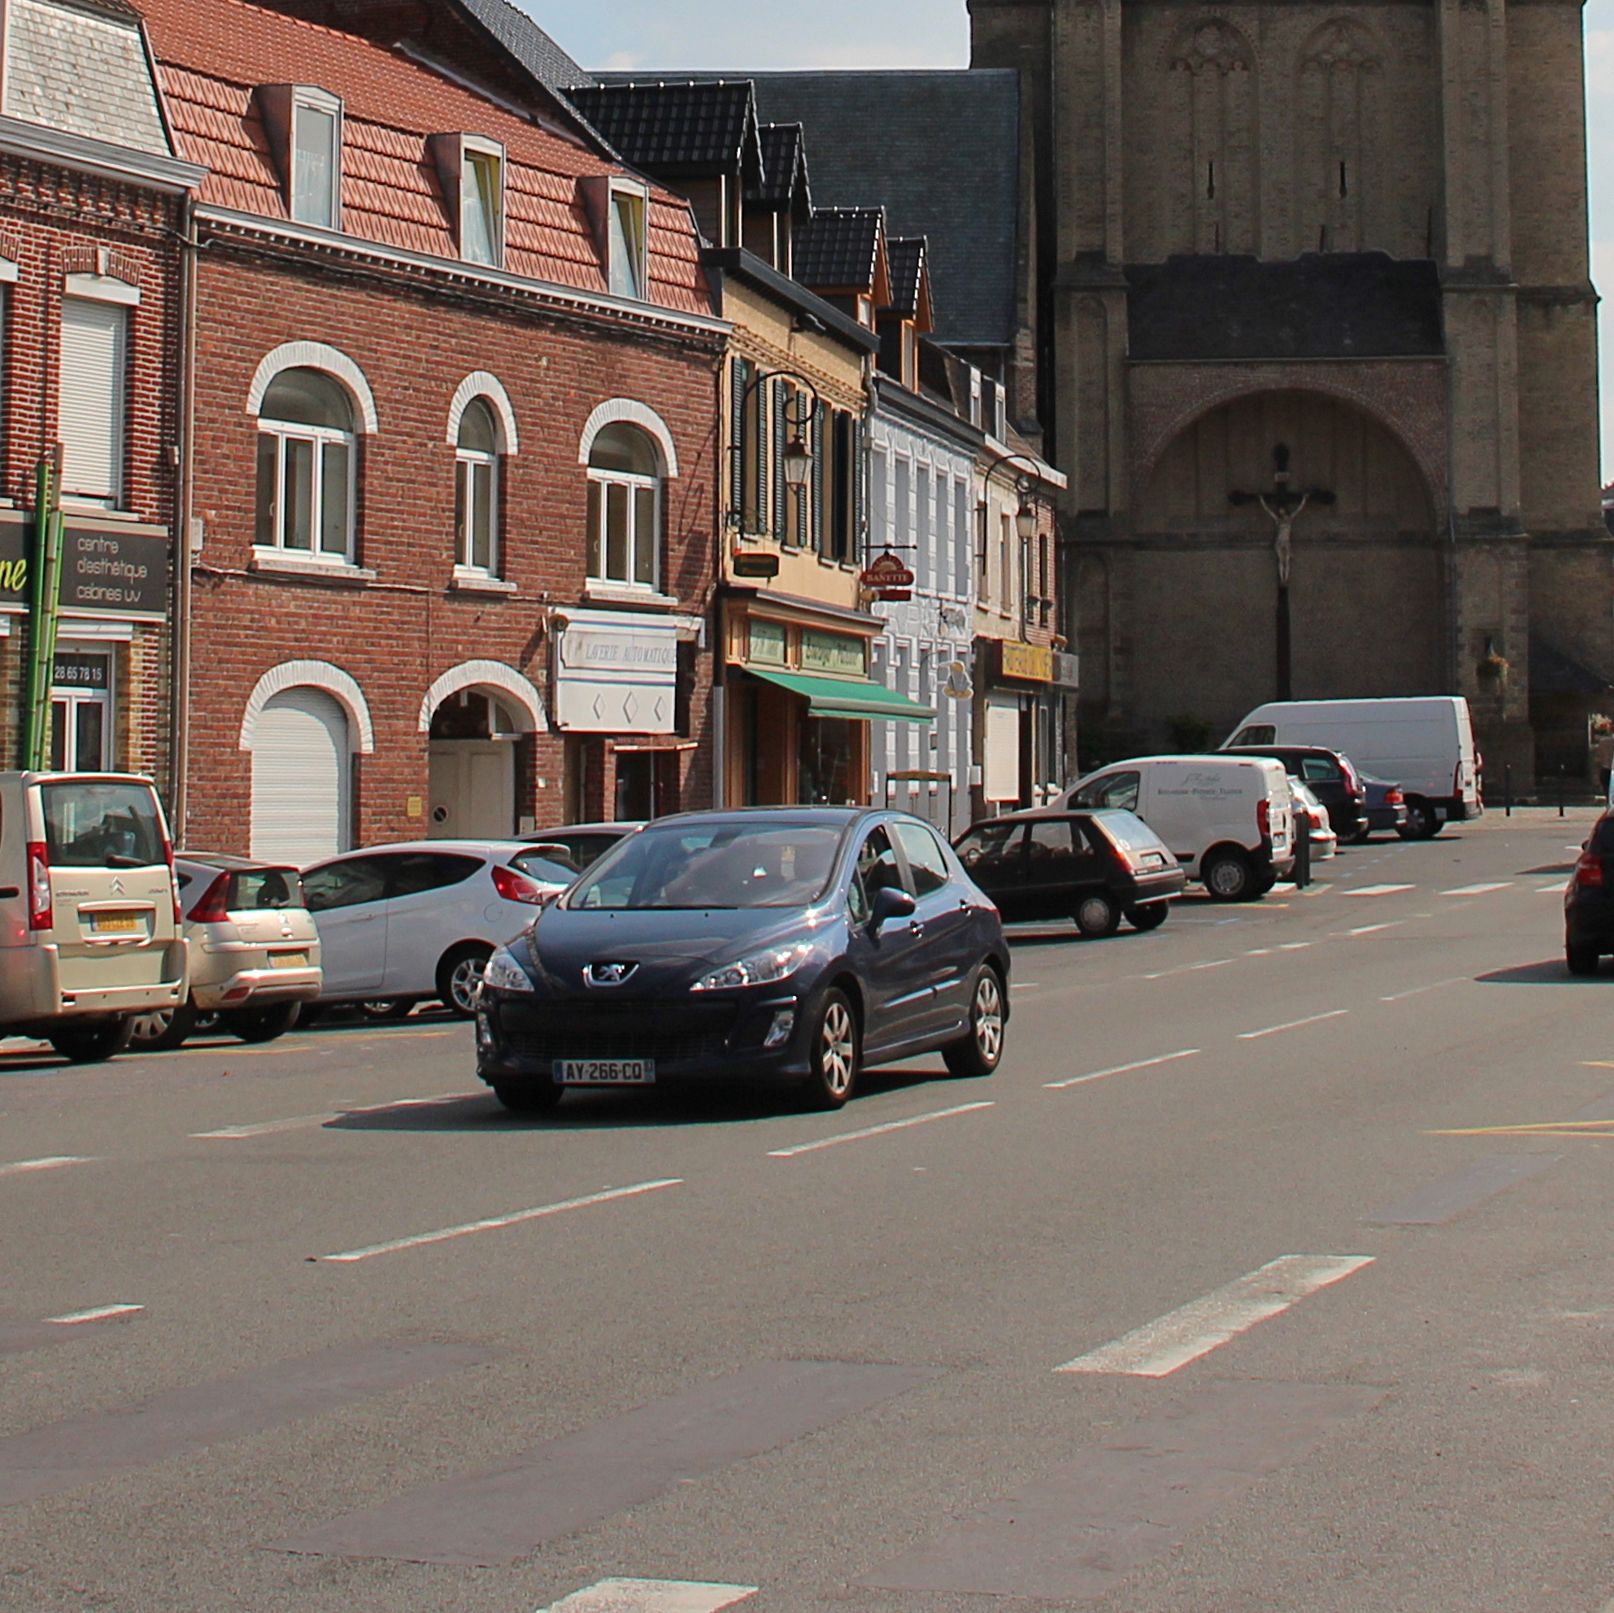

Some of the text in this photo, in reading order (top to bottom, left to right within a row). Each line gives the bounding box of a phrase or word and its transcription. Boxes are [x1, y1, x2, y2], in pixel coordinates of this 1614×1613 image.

[77, 536, 119, 554] centre
[866, 573, 909, 582] BANETTE
[586, 643, 677, 665] LAVERIE AUTOMATIQUE
